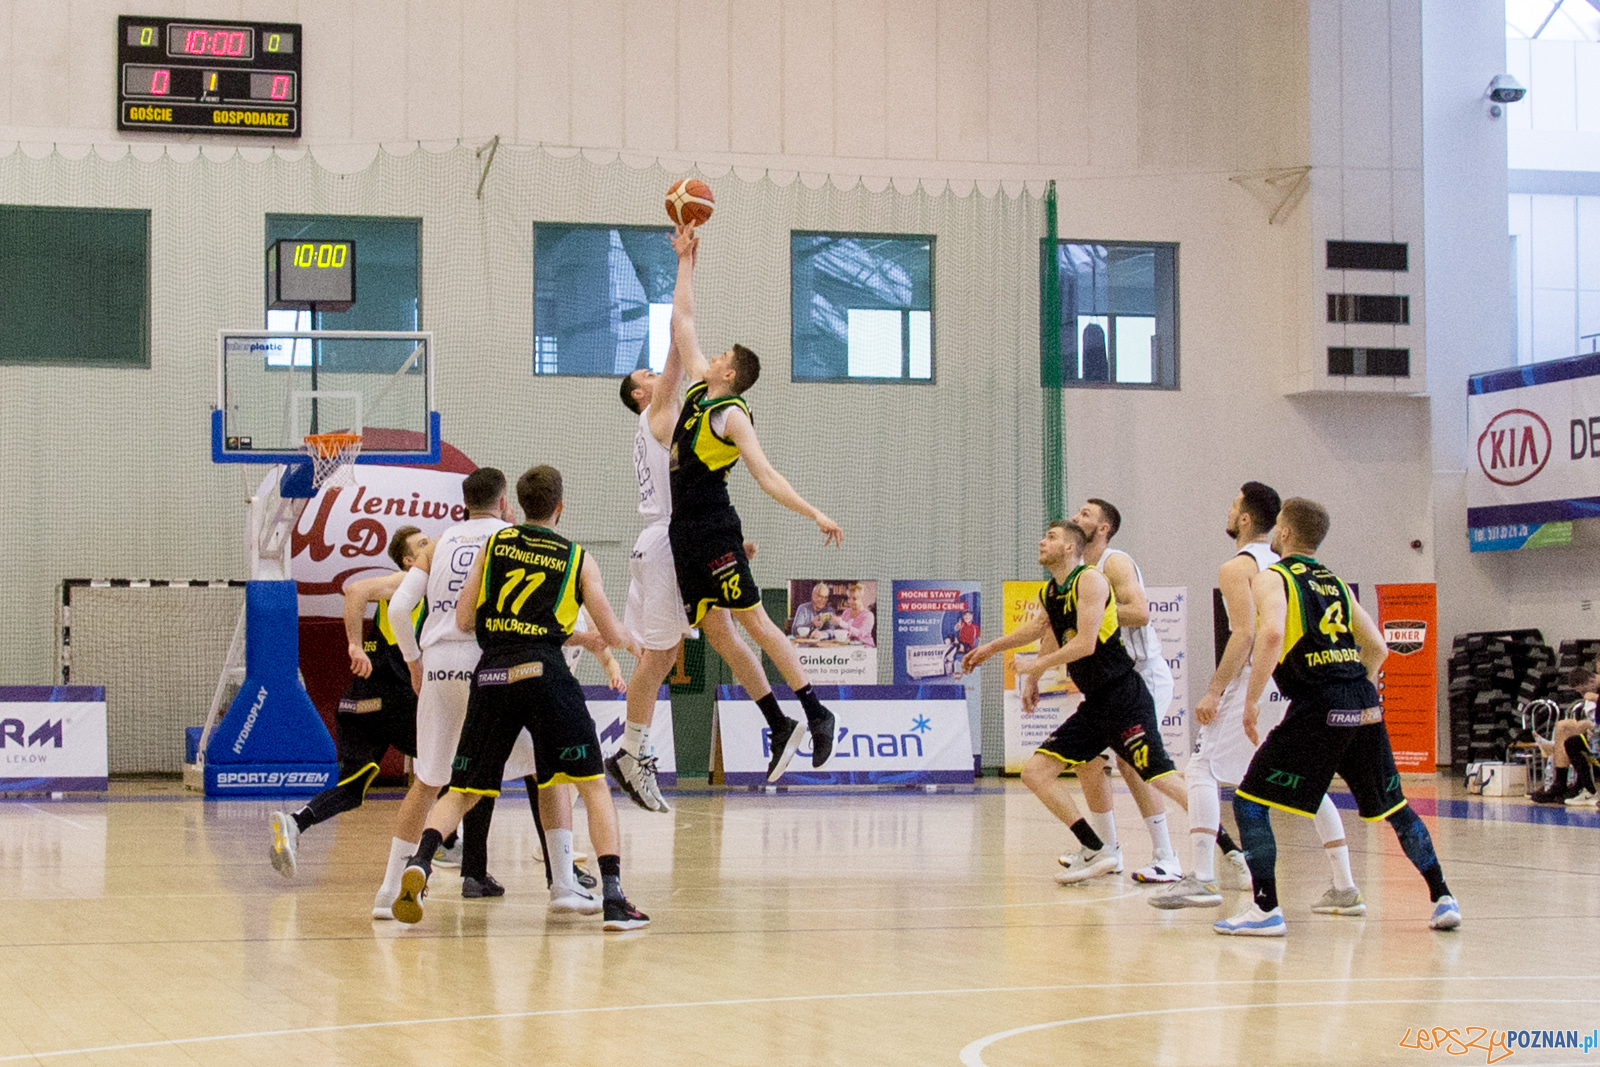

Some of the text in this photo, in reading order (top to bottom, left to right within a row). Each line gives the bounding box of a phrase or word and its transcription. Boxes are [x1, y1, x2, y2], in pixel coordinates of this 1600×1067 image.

[140, 28, 152, 46] 0
[185, 30, 245, 56] 10:00
[268, 34, 280, 52] 0
[151, 70, 170, 95] 0
[209, 73, 217, 91] 1
[270, 76, 289, 100] 0
[130, 106, 172, 122] GOŚCIE
[213, 110, 289, 126] GOSPODARZE
[294, 244, 347, 268] 10:00
[1490, 426, 1538, 470] KIA
[494, 544, 567, 573] CZYŻNIELEWSKI
[496, 567, 546, 616] 11
[721, 573, 742, 602] 18
[901, 591, 958, 600] MOCNE STAWY
[901, 602, 966, 611] W DOBREJ CENIE
[1319, 600, 1348, 644] 4
[1388, 630, 1421, 641] JOKER
[799, 655, 850, 666] Ginkofar
[232, 686, 269, 755] HYDROPLAY
[217, 772, 329, 787] SPORTSYSTEM
